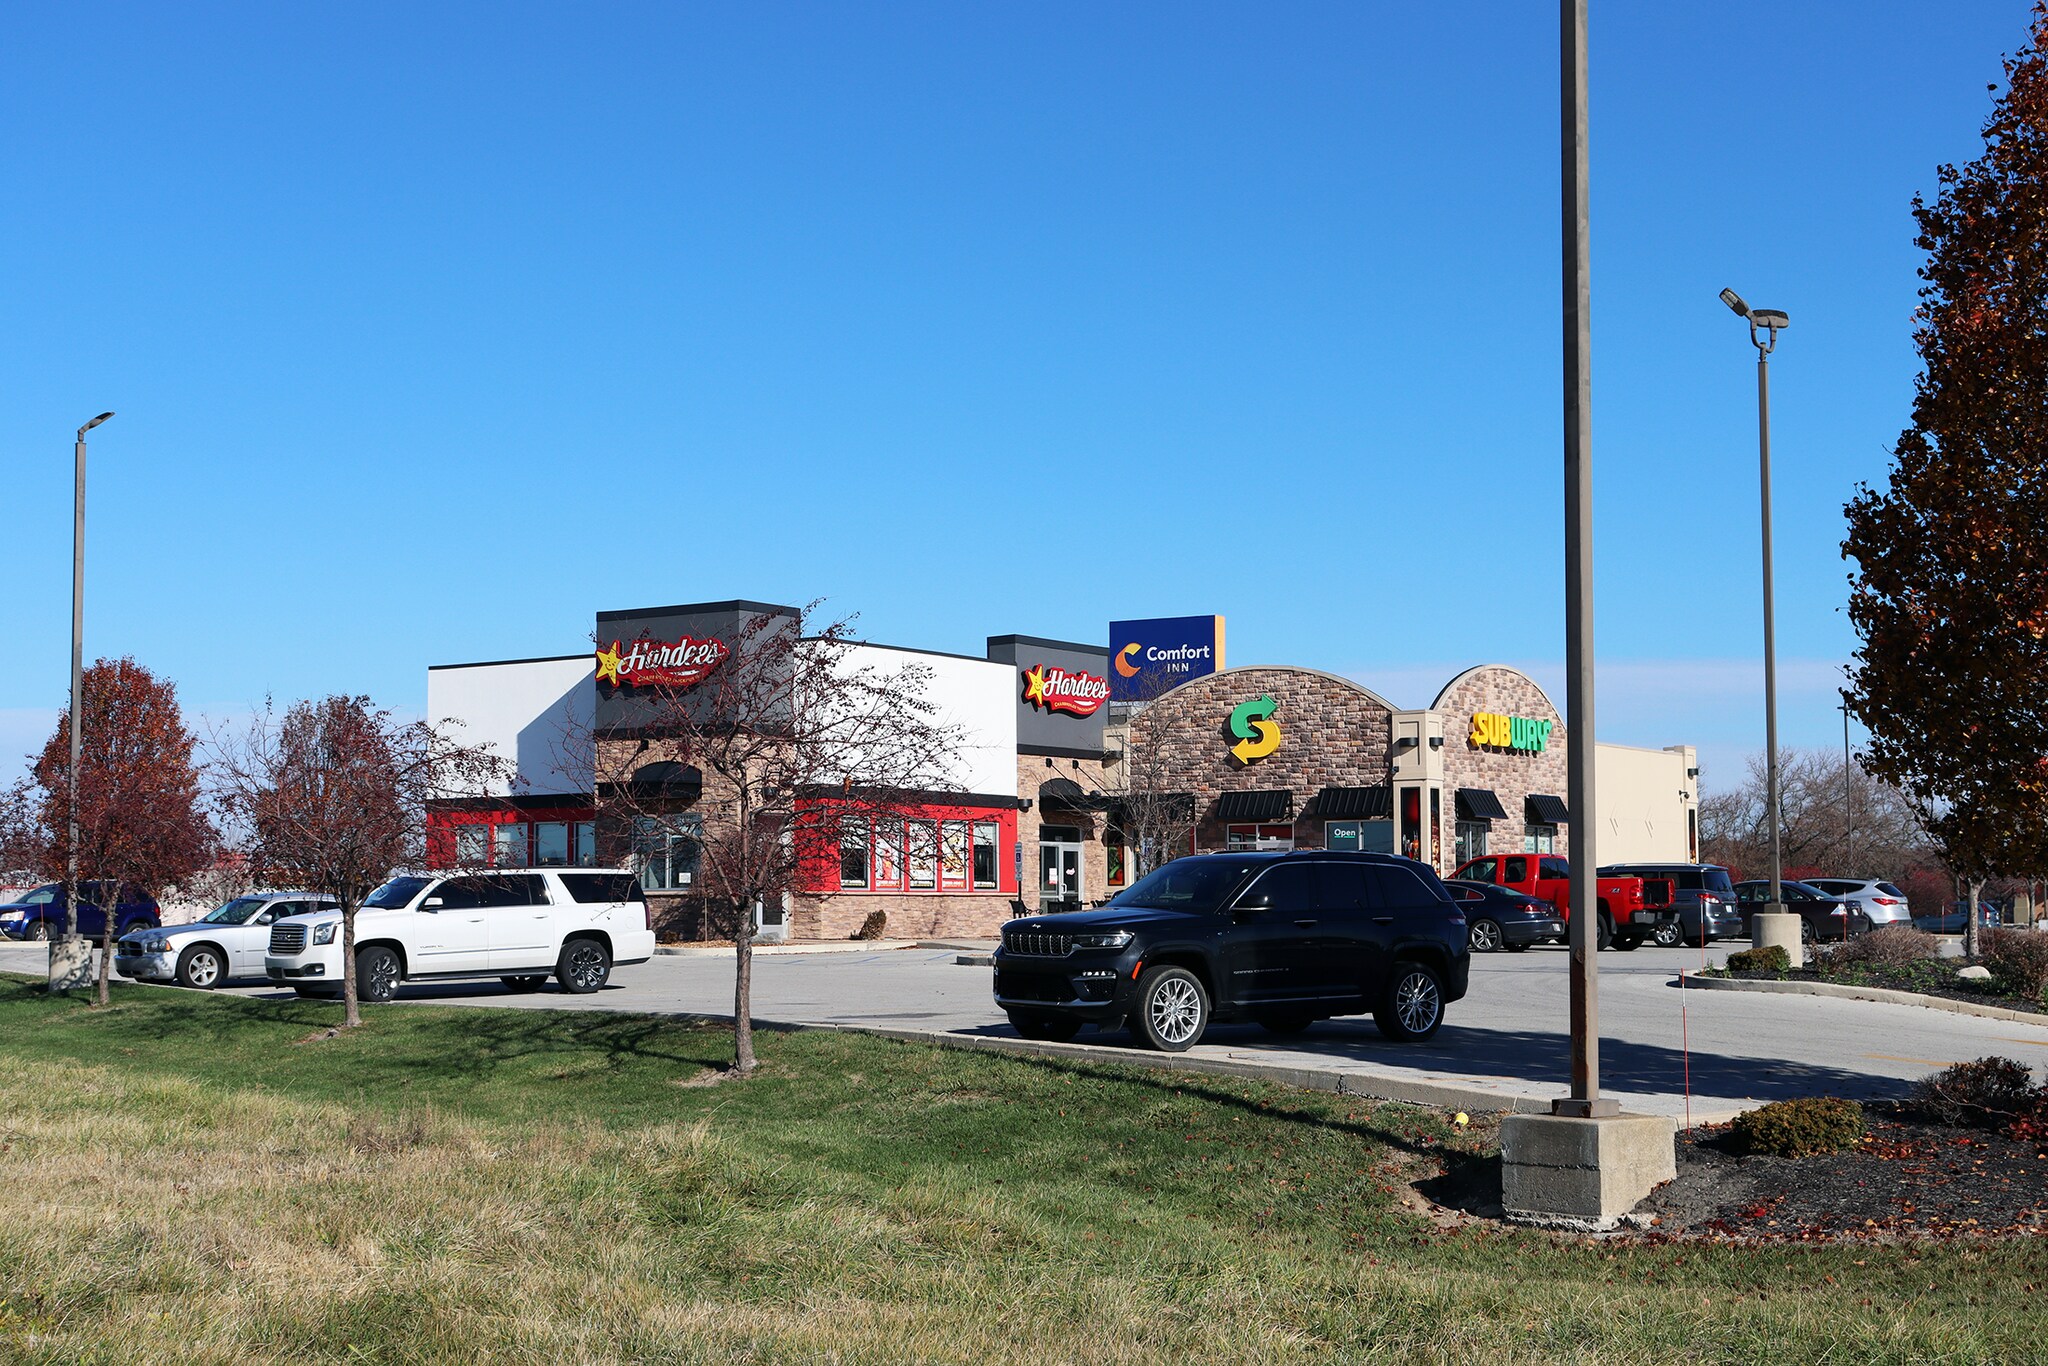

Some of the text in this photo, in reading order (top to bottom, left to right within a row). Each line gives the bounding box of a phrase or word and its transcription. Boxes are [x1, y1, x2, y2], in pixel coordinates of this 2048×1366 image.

[616, 638, 726, 675] Hardee's
[1146, 643, 1210, 662] Comfort
[1167, 662, 1190, 673] INN
[1042, 669, 1111, 699] Hardee's
[1470, 712, 1552, 752] SUBWAY
[1334, 828, 1356, 838] Open
